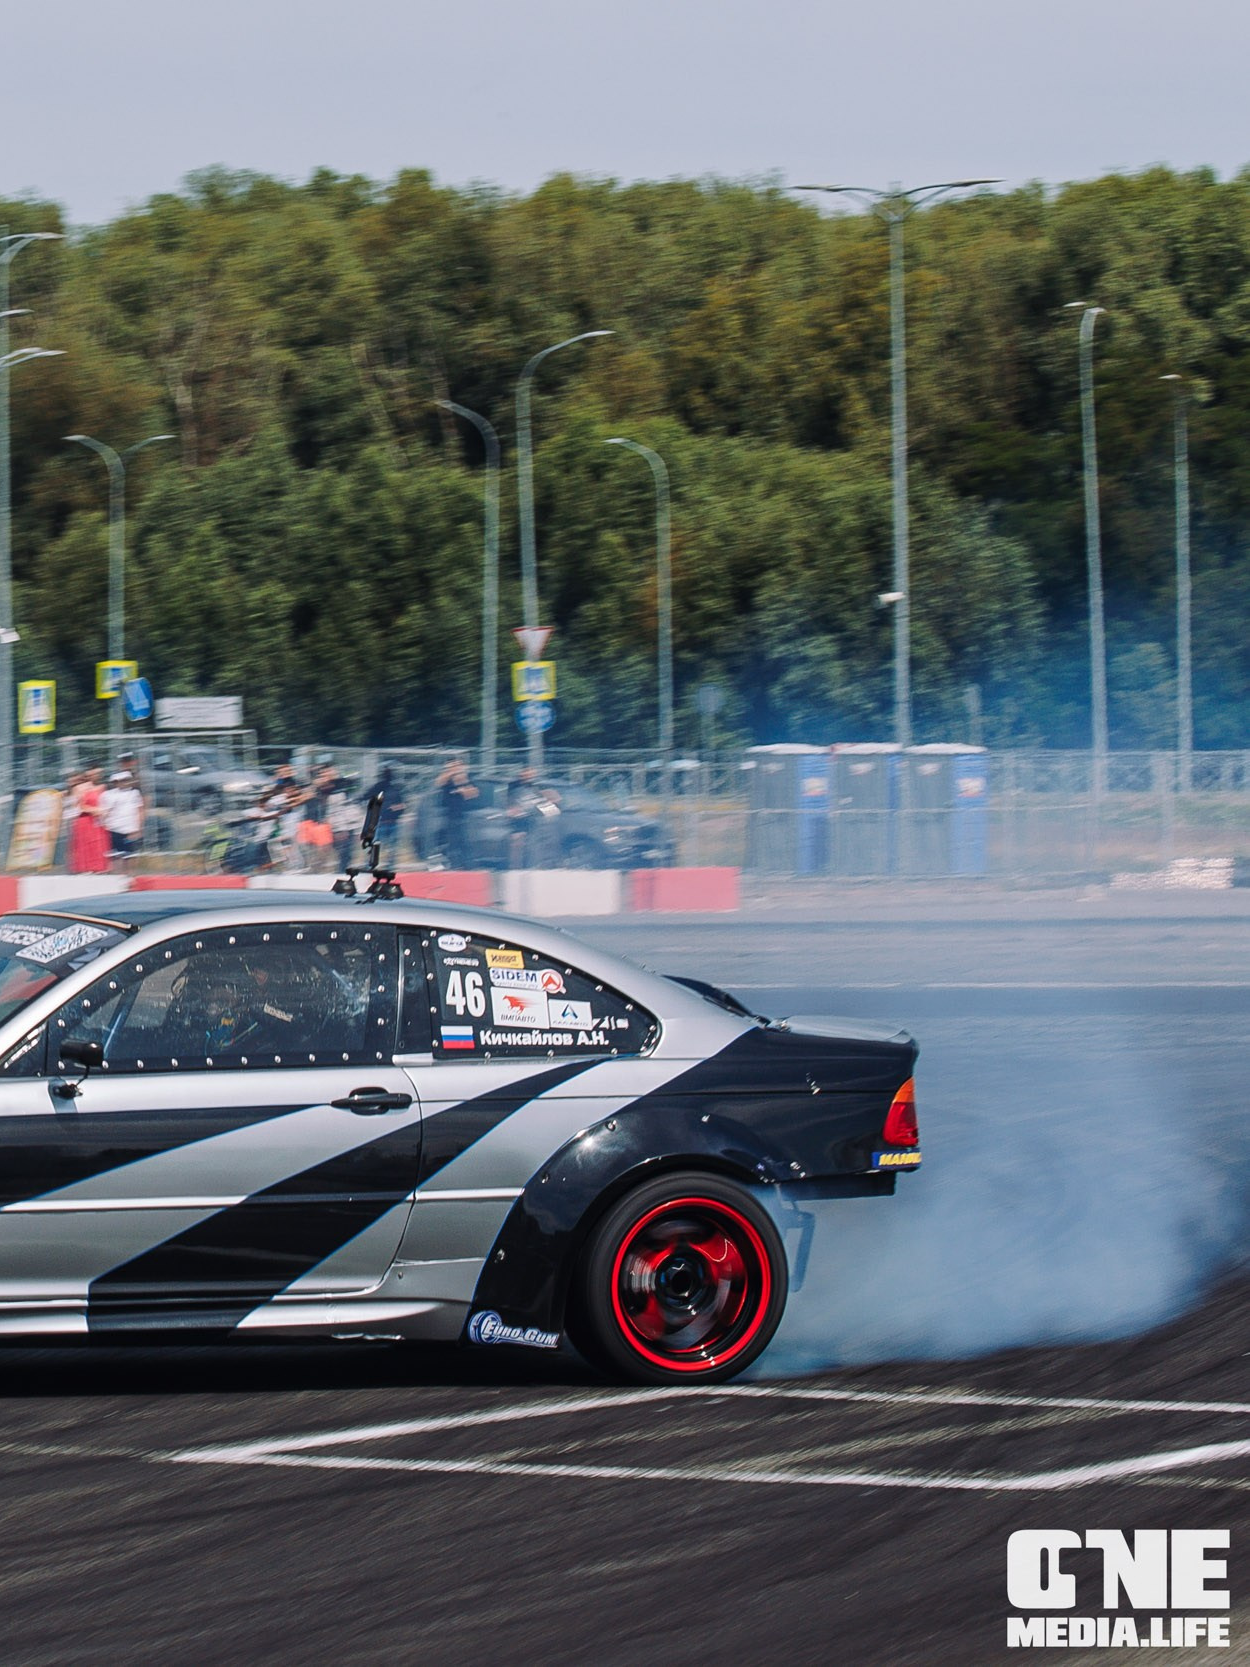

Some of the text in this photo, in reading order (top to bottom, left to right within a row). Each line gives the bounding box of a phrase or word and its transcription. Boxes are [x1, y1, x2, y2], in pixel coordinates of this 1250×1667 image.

[491, 968, 537, 983] SIDEM
[446, 970, 486, 1017] 46
[479, 1029, 610, 1046] Кичкайлов А.Н.
